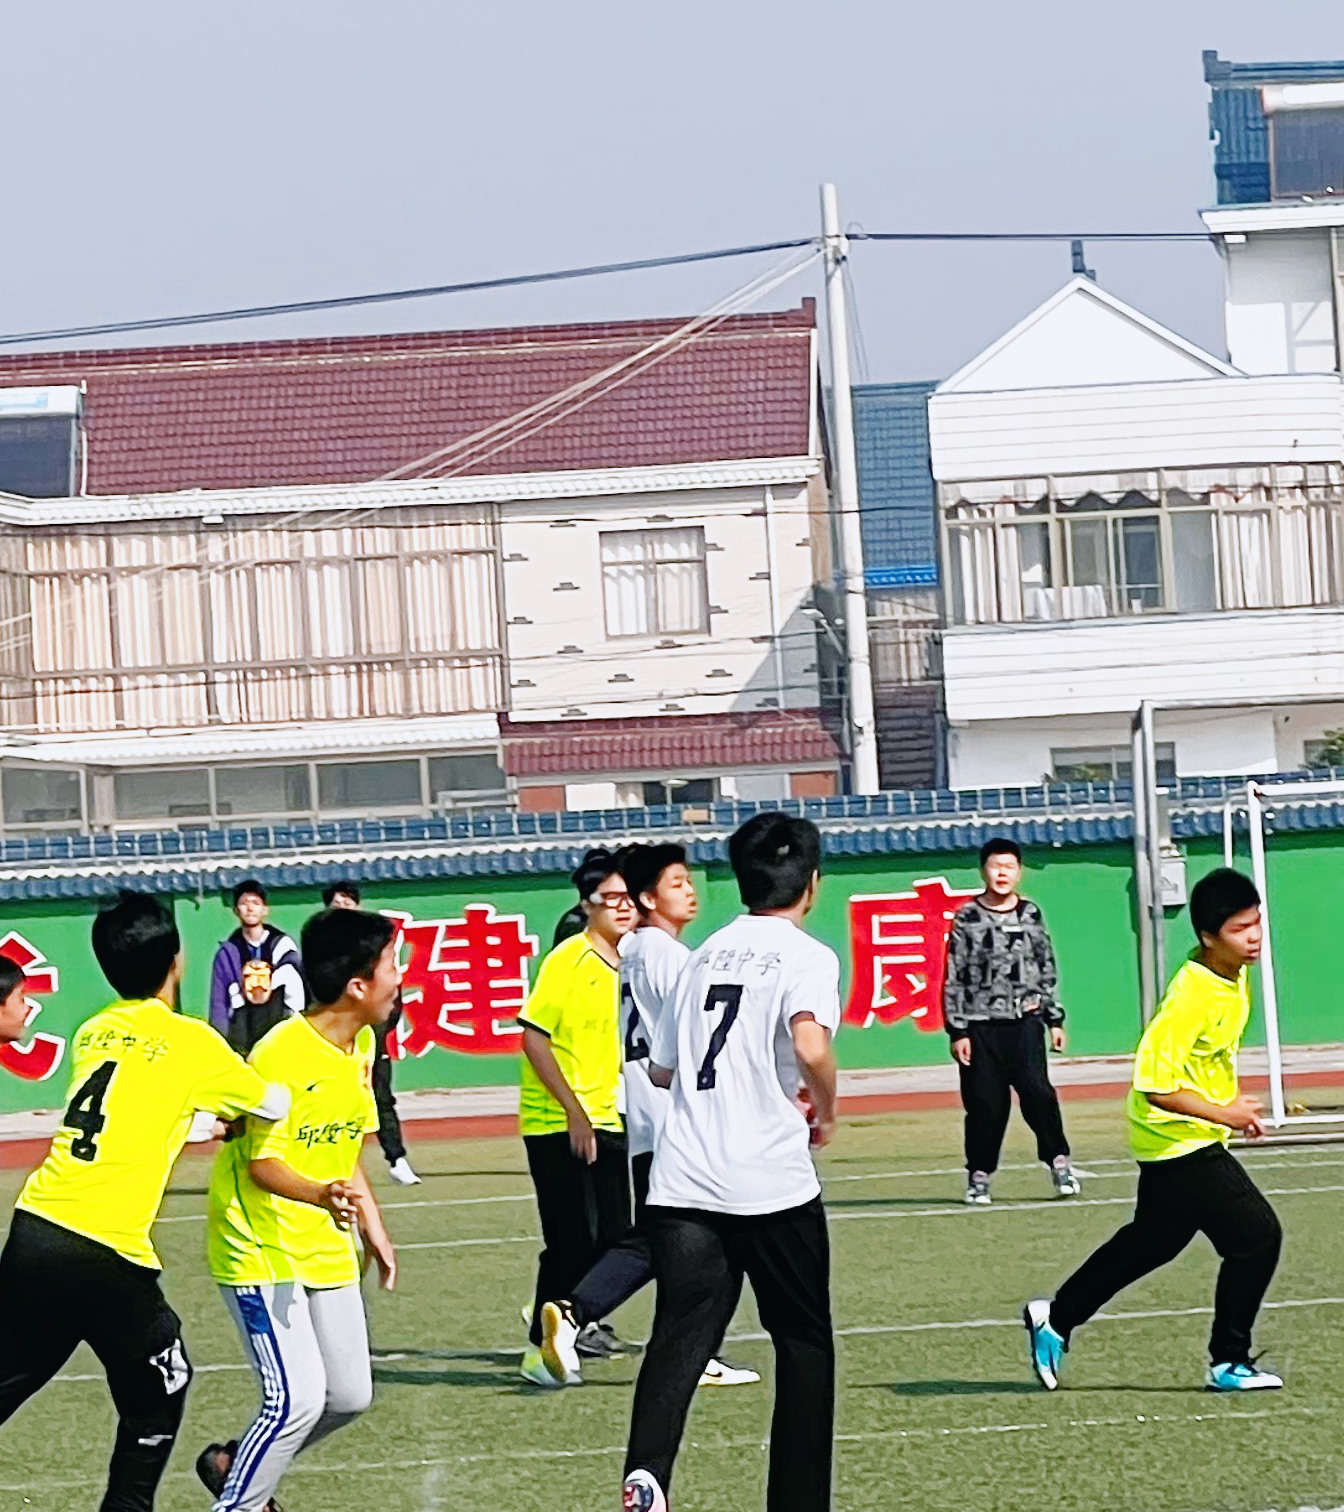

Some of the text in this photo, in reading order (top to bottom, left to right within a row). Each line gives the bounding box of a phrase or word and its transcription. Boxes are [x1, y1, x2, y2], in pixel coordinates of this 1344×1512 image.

[379, 903, 539, 1060] 健
[842, 876, 986, 1032] 康
[621, 983, 650, 1062] 2
[697, 984, 745, 1091] 7
[64, 1060, 118, 1161] 4
